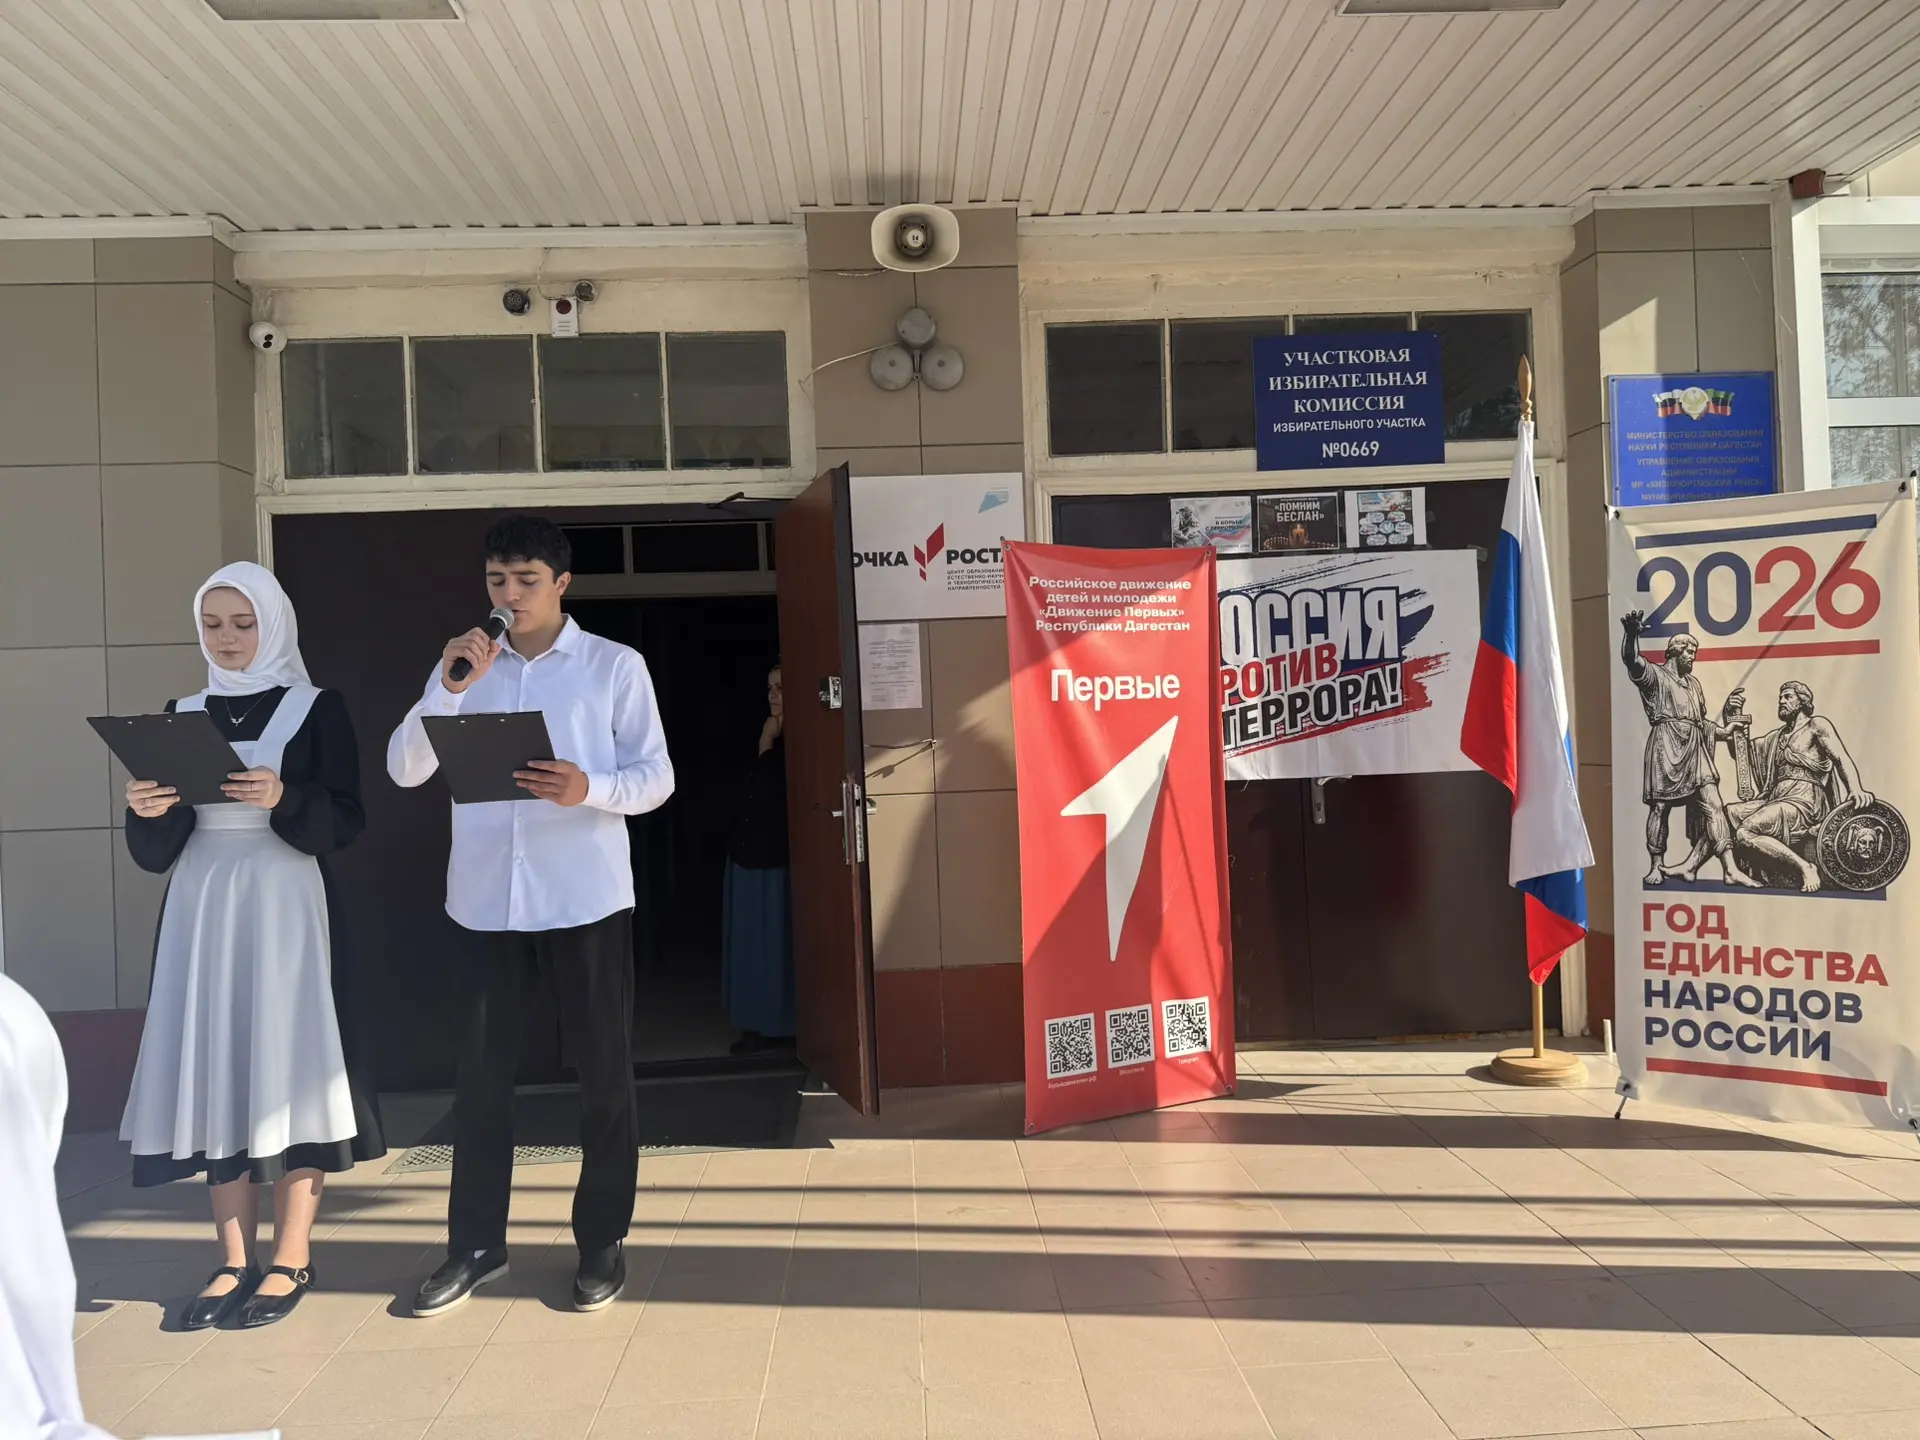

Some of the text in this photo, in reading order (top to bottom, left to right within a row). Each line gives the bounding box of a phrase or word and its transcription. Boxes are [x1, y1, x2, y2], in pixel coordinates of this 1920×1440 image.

[1283, 348, 1411, 367] УЧАСТКОВАЯ
[1268, 371, 1428, 391] ИЗБИРАТЕЛЬНАЯ
[1293, 395, 1405, 414] КОМИССИЯ
[1273, 417, 1426, 433] ИЗБИРАТЕЛЬНОГО УЧАСТКА
[1627, 431, 1698, 440] МИНИСТЕРСТВО
[1322, 440, 1380, 458] №0669
[1628, 443, 1657, 451] НАУКИ
[1719, 441, 1763, 449] ДАГЕСТАН
[1274, 501, 1320, 512] «ПОМНИМ
[1276, 511, 1325, 522] БЕСЛАН»
[1029, 576, 1192, 591] Российское движение
[1636, 540, 1881, 638] 2026
[1046, 592, 1177, 605] детей и молодежи
[1039, 606, 1185, 619] «Движение Первых»
[1036, 620, 1191, 634] Республики Дагестан
[1051, 669, 1181, 711] Первые
[1222, 667, 1402, 747] ТЕРРОРА!
[1642, 903, 1730, 940] ГОД
[1643, 941, 1889, 986] ЕДИНСТВА
[1644, 979, 1863, 1024] НАРОДОВ
[1645, 1016, 1831, 1062] РОССИИ
